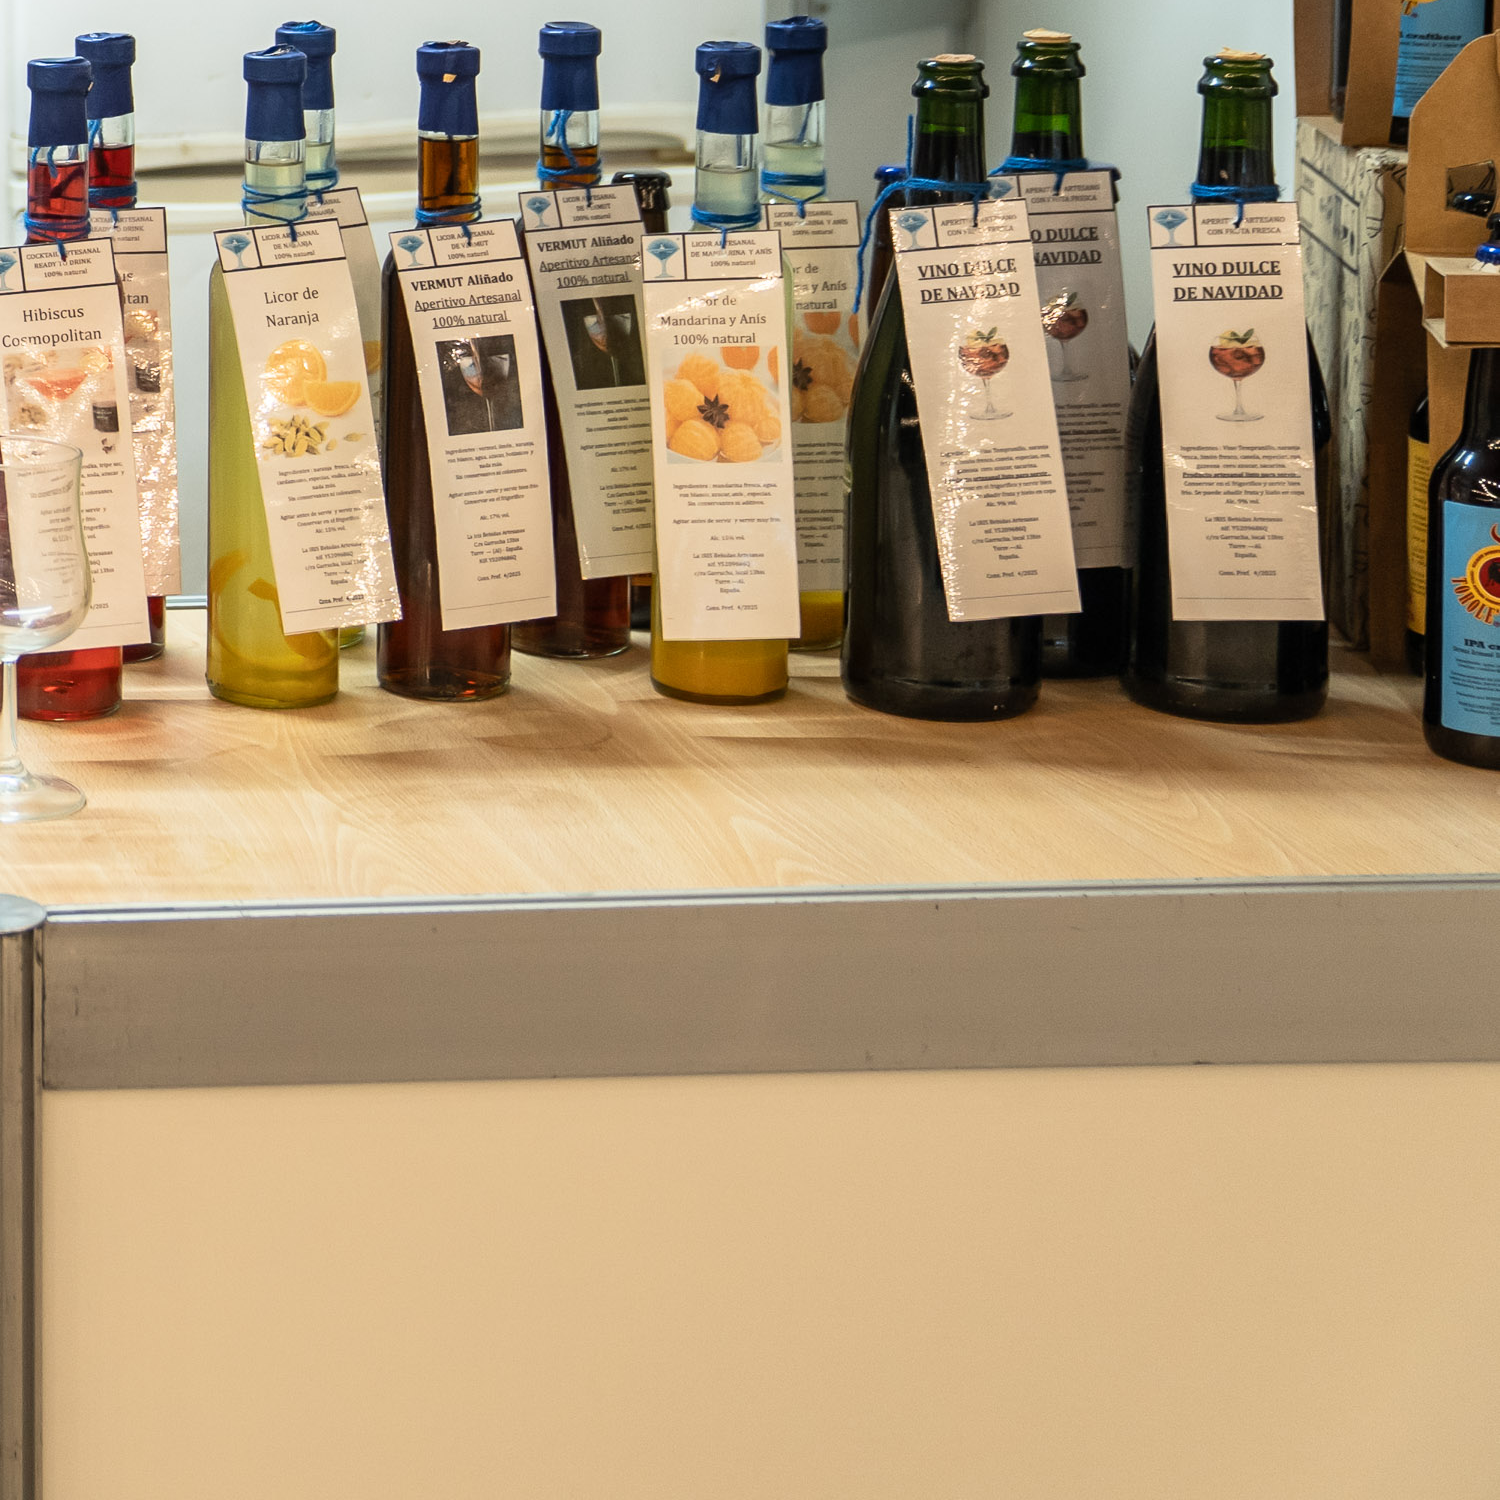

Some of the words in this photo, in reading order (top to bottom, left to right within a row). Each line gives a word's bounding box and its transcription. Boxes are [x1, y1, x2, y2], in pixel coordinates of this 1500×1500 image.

[1201, 217, 1231, 226] APERIT
[261, 232, 281, 242] LICOR
[281, 229, 320, 240] ARESANAL
[436, 233, 456, 242] LICOR
[947, 229, 961, 237] CON
[1046, 226, 1099, 242] DULCE
[1206, 228, 1224, 236] CON
[1252, 226, 1281, 235] FRESCA
[451, 242, 460, 250] DE
[537, 238, 587, 253] VERMUT
[591, 234, 634, 248] Aliñado
[691, 240, 713, 248] LICOR
[65, 247, 101, 256] TESANAL
[274, 252, 293, 260] 100%
[447, 252, 466, 260] 100%
[466, 250, 489, 258] natural
[1034, 249, 1102, 266] NAVIDAD
[34, 260, 57, 269] READY
[69, 257, 92, 265] DRINK
[540, 258, 590, 273] Aperitivo
[710, 260, 731, 268] 100%
[731, 259, 756, 267] natural
[804, 263, 819, 274] de
[1172, 262, 1217, 278] VINO
[1222, 260, 1281, 276] DULCE
[64, 268, 88, 277] natural
[917, 262, 960, 279] VINO
[411, 277, 464, 292] VERMUT
[467, 272, 513, 287] Aliñado
[556, 275, 589, 289] 100%
[591, 271, 630, 286] natural
[811, 284, 819, 294] y
[821, 280, 848, 292] Anís
[1173, 286, 1198, 302] DE
[1202, 284, 1284, 301] NAVIDAD
[264, 290, 299, 305] Licor
[302, 286, 320, 300] de
[414, 296, 466, 313] Aperitivo
[469, 289, 522, 306] Artesanal
[722, 295, 737, 307] de
[920, 287, 943, 303] DE
[795, 299, 838, 310] natural
[22, 306, 85, 323] Hibiscus
[266, 310, 320, 328] Naranja
[432, 315, 466, 330] 100%
[467, 310, 510, 325] natural
[660, 315, 727, 327] Mandarina
[729, 317, 737, 327] y
[739, 313, 767, 325] Anís
[1, 328, 103, 349] Cosmopolitan
[673, 333, 709, 345] 100%
[712, 332, 756, 345] natural
[1463, 637, 1485, 650] IPA
